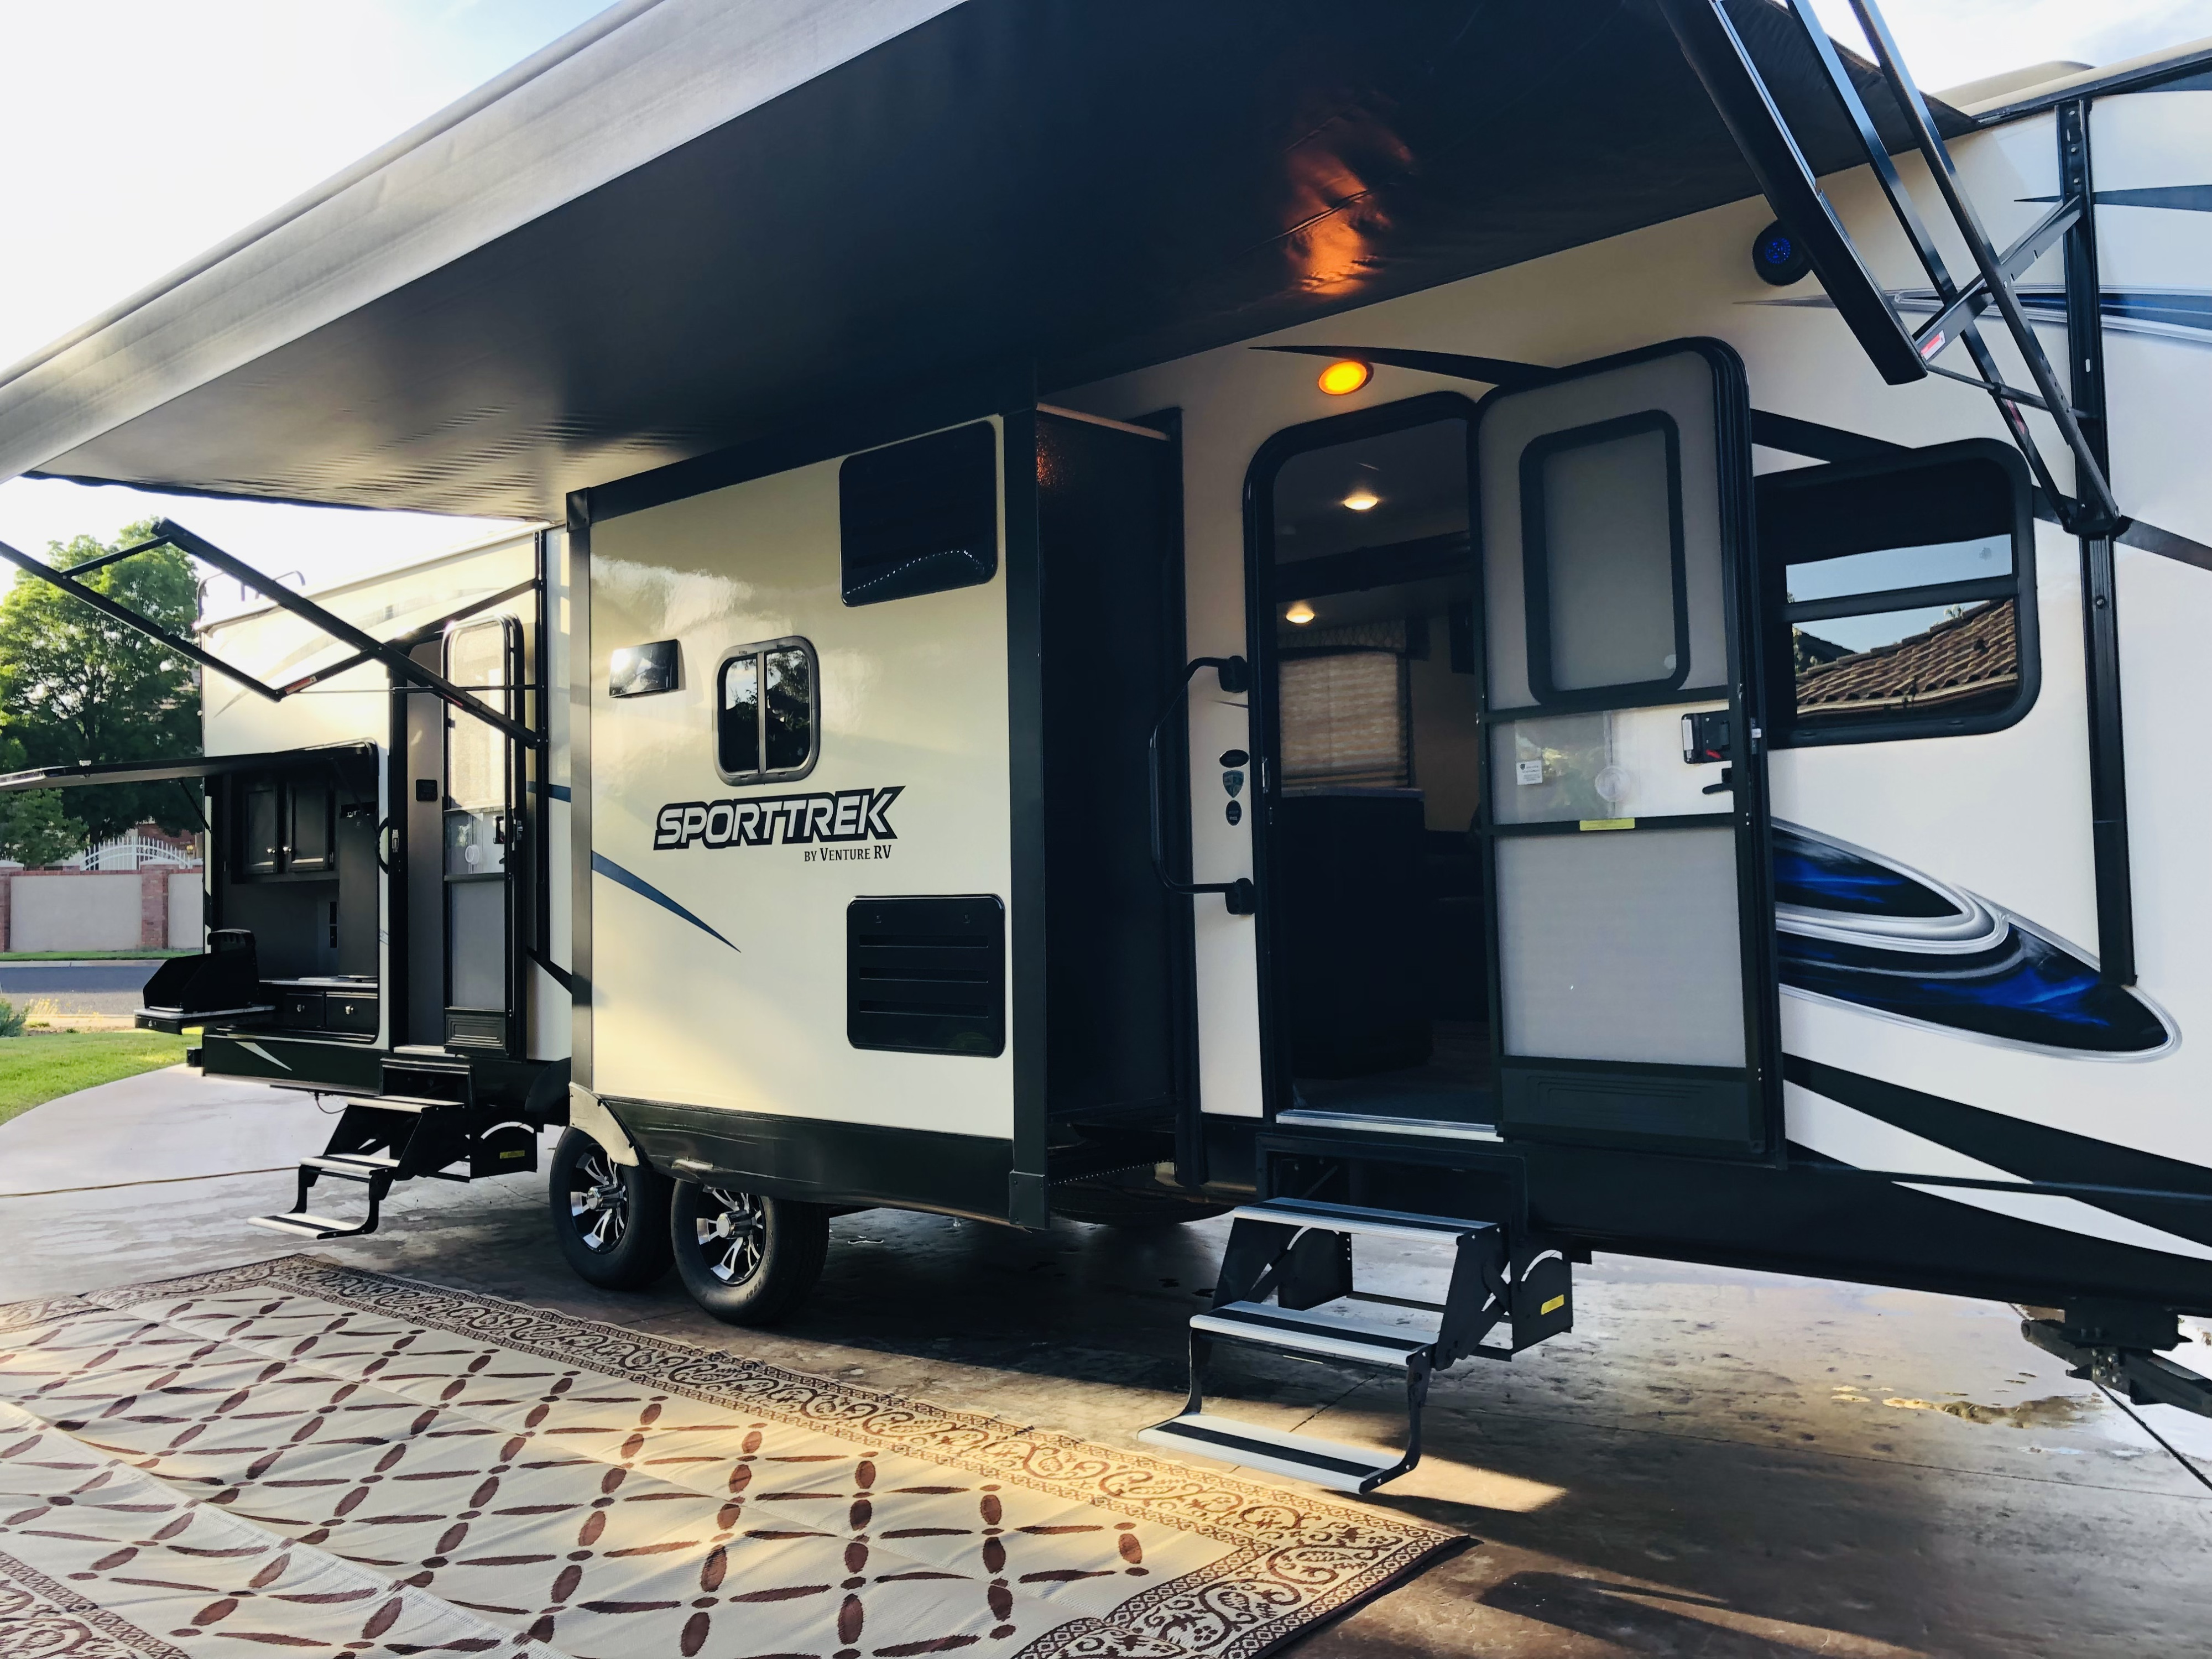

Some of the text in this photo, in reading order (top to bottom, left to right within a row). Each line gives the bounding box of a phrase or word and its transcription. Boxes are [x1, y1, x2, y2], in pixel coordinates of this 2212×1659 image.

[654, 786, 906, 851] SPORTTREK
[804, 844, 892, 862] BY VENTURE RV
